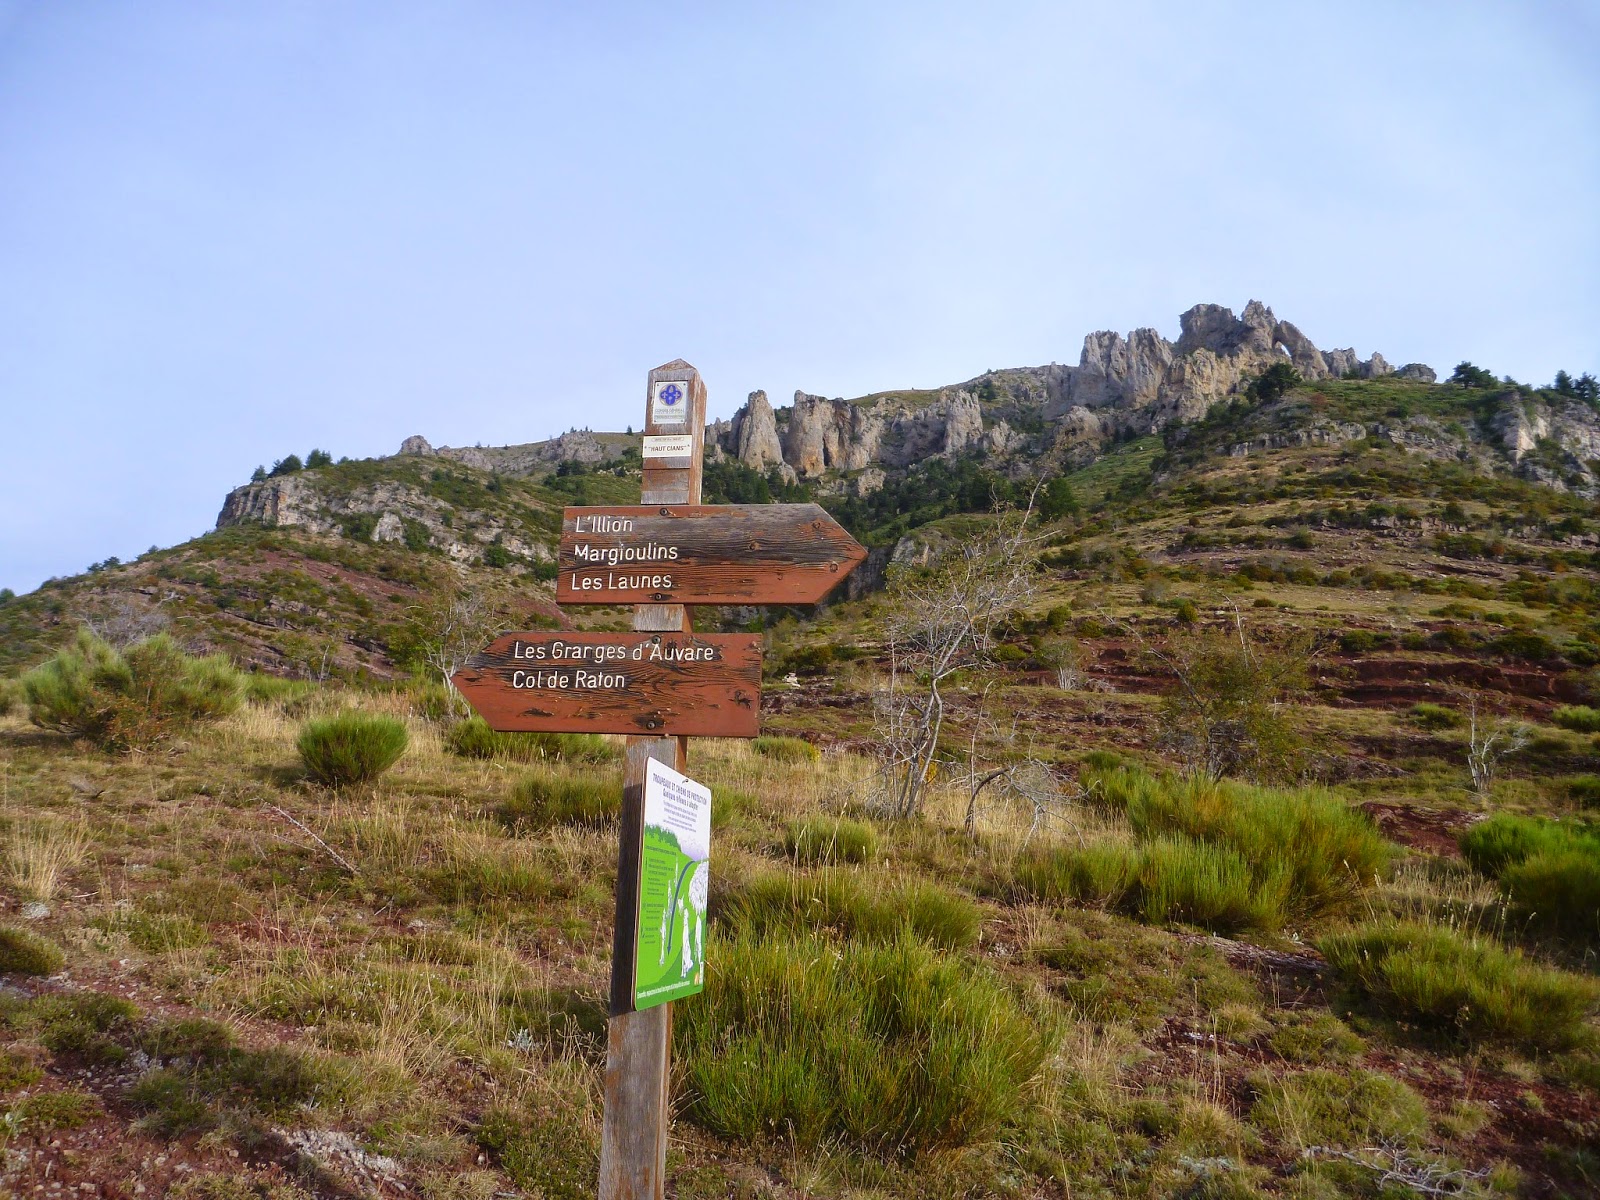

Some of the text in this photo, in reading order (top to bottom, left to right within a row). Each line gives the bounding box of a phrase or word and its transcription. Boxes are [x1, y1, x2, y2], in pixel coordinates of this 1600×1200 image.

[575, 515, 633, 533] L'Illion
[573, 543, 679, 565] Margioulins
[571, 572, 672, 590] Les Launes
[514, 641, 714, 663] Les Granges d'Auvare
[512, 671, 625, 689] Col de Raton
